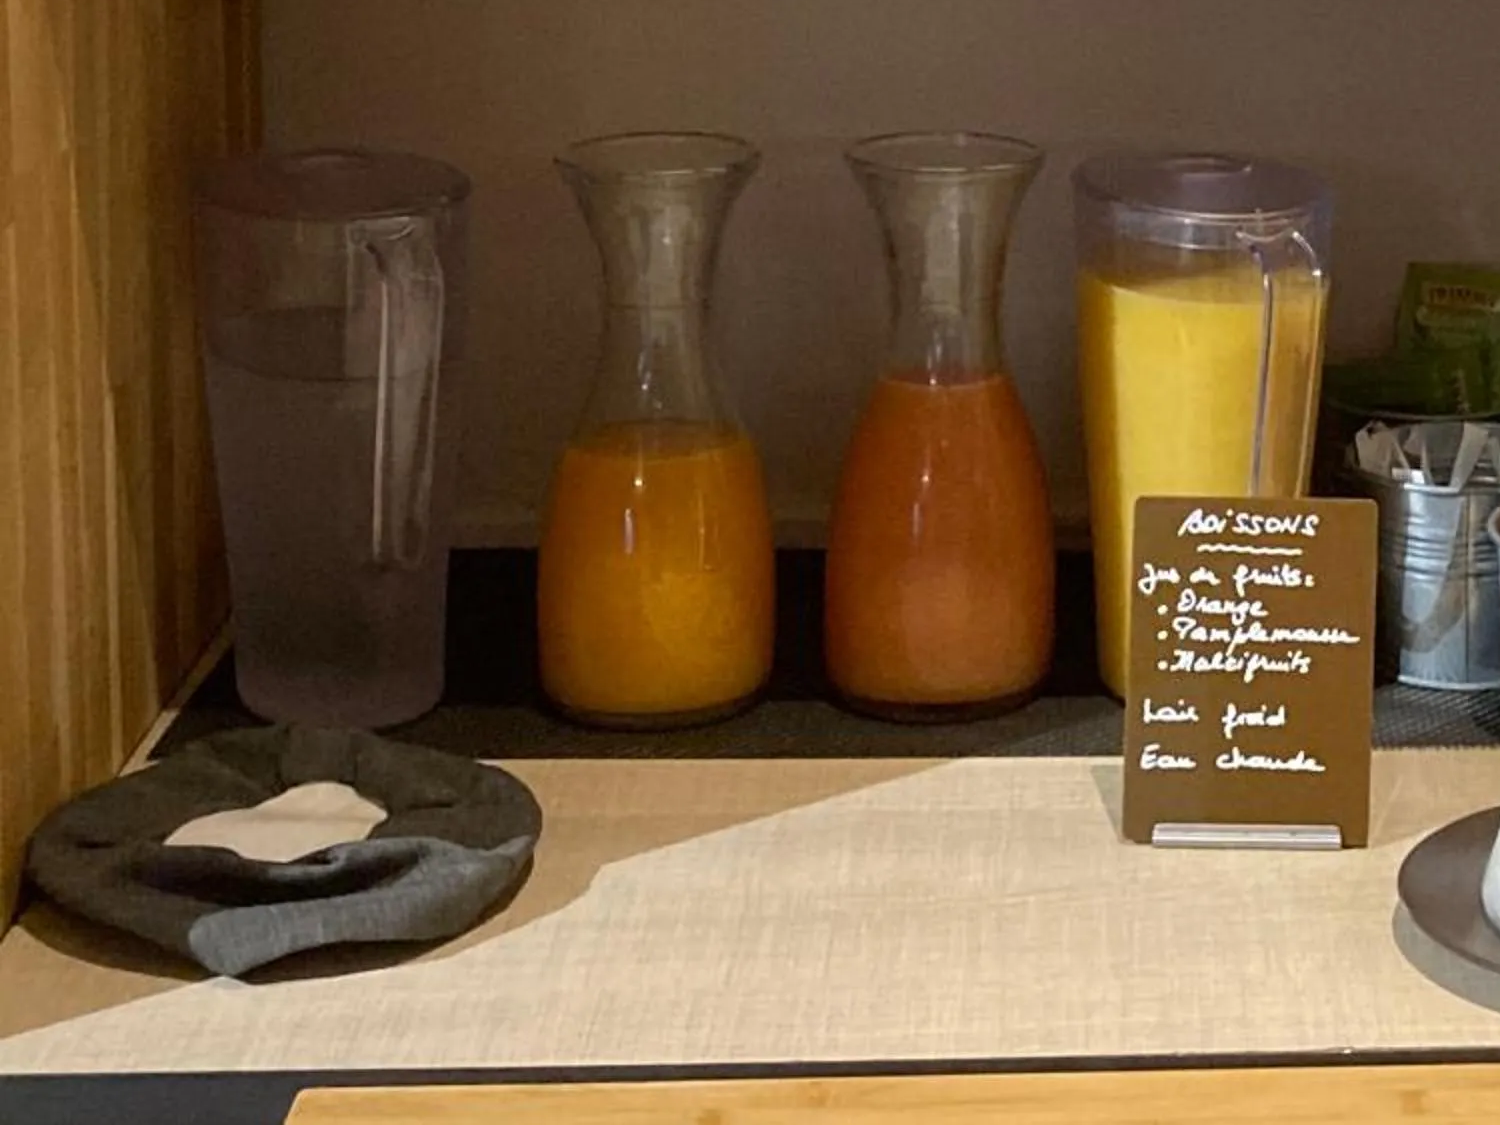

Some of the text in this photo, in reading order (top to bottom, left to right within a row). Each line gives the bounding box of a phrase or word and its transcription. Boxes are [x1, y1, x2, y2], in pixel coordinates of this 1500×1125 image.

[1177, 588, 1269, 625] Orange
[1221, 702, 1286, 739] froid
[1140, 743, 1326, 772] Eau chaude
